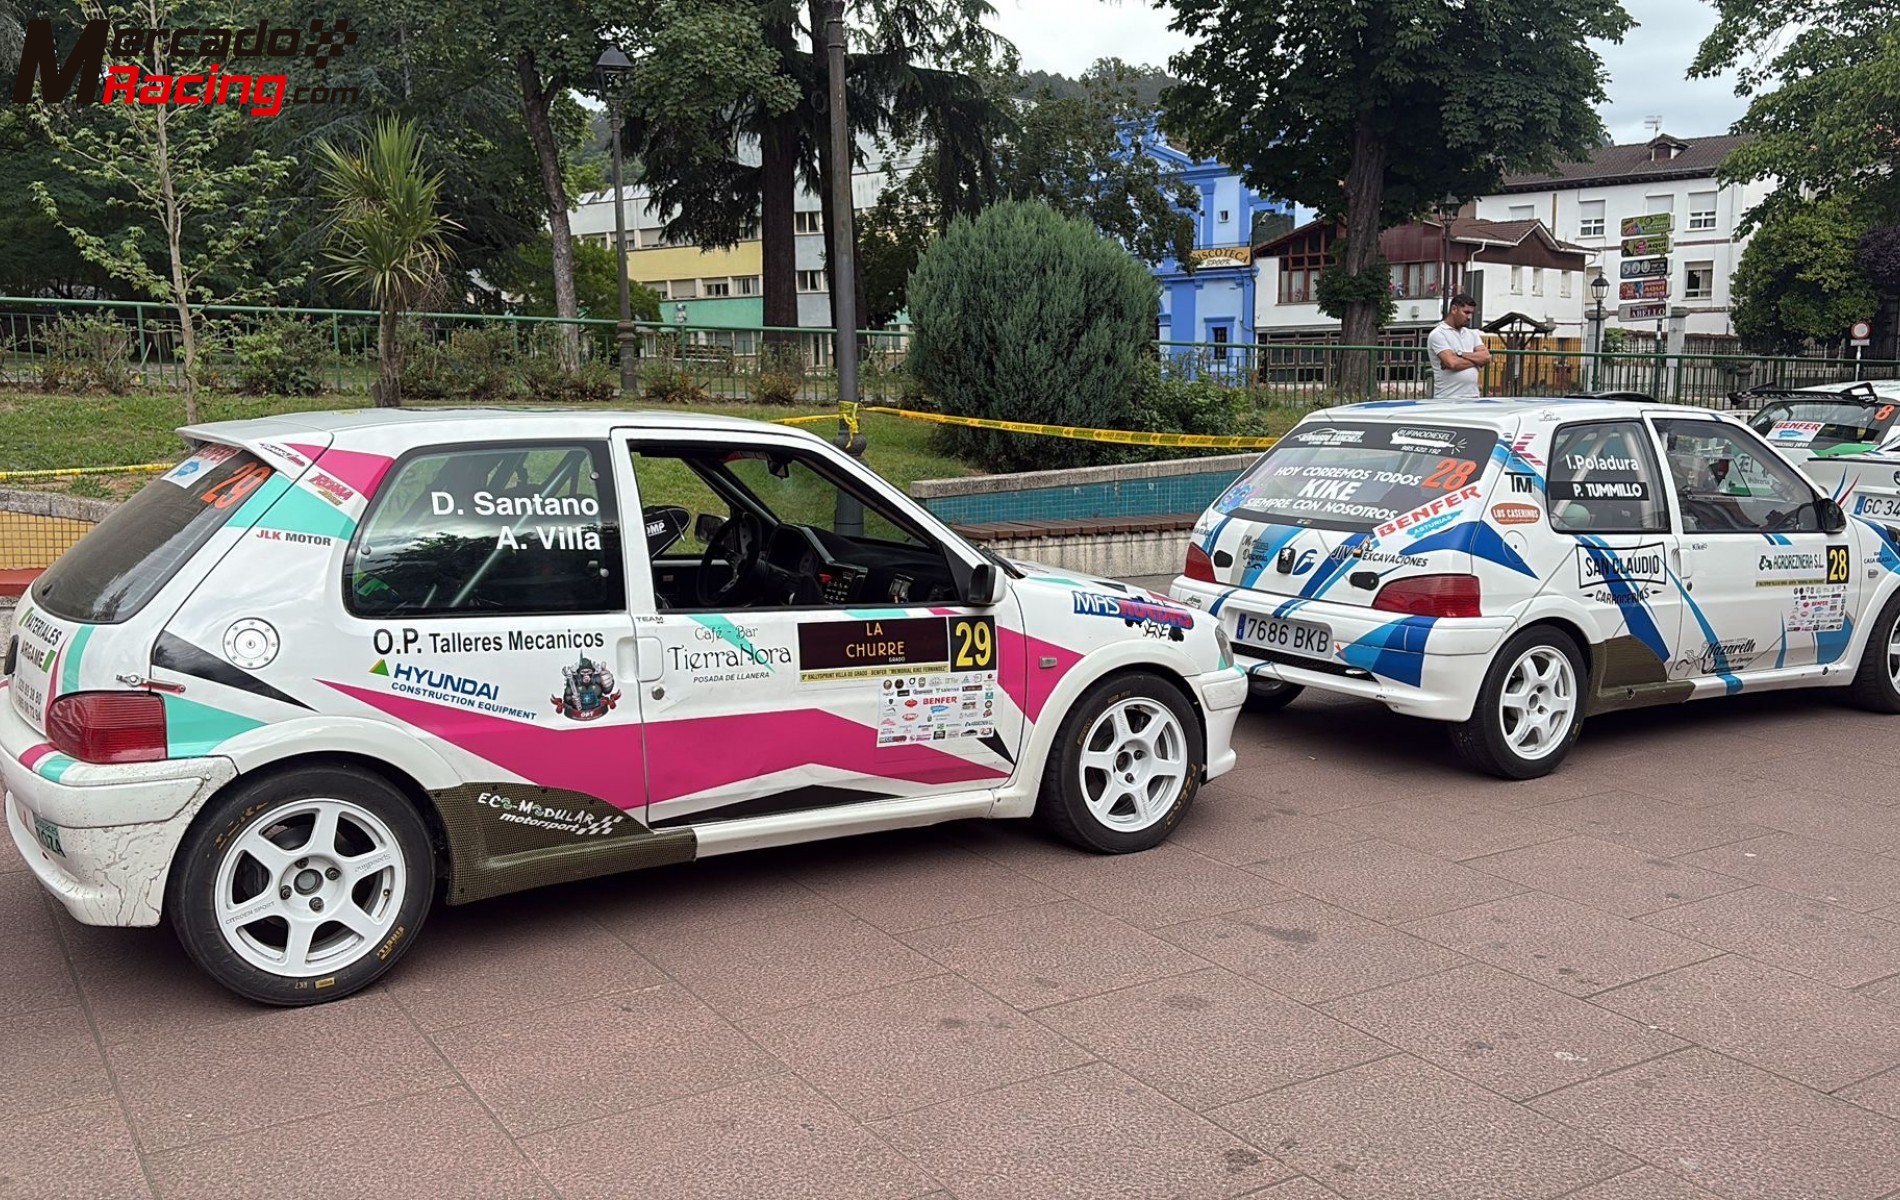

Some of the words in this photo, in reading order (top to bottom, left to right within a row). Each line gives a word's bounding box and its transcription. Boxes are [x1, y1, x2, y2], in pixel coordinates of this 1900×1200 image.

[1874, 404, 1896, 422] 8
[1775, 422, 1822, 431] BENFER
[1566, 454, 1640, 471] I.Poladura
[1274, 466, 1302, 477] HOY
[1302, 467, 1371, 480] CORREMOS
[1374, 471, 1422, 487] TODOS
[1421, 458, 1478, 491] 28
[200, 462, 273, 510] 29
[1298, 478, 1363, 501] KIKE
[1572, 483, 1584, 497] P.
[1585, 483, 1642, 497] TUMMILLO
[431, 491, 464, 516] D.
[474, 491, 599, 516] Santano
[1244, 497, 1292, 509] SIEMPRE
[1293, 500, 1320, 512] CON
[1322, 503, 1399, 521] NOSOTROS
[1378, 485, 1482, 538] BENFER
[1863, 499, 1882, 515] GC
[1413, 515, 1451, 534] ASTURIAS
[255, 529, 282, 542] JLK
[285, 531, 332, 547] MOTOR
[495, 525, 527, 551] A.
[536, 525, 601, 550] Villa
[1362, 551, 1429, 568] EXCAVACIONES
[1585, 557, 1609, 577] SAN
[1612, 555, 1660, 575] CLAUDIO
[1829, 548, 1847, 581] 28
[1075, 592, 1120, 614] MAS
[24, 613, 62, 646] MATERIALES
[694, 624, 723, 641] Café
[735, 624, 759, 639] Bar
[866, 622, 884, 637] LA
[1246, 618, 1289, 646] 7686
[1293, 626, 1330, 653] BKB
[373, 628, 422, 655] O.P.
[429, 632, 503, 654] Talleres
[508, 629, 604, 651] Mecanicos
[846, 641, 906, 658] CHURRE
[954, 621, 993, 668] 29
[667, 643, 792, 673] TierraNora
[393, 662, 500, 701] HYUNDAI
[693, 675, 724, 683] POSADA
[725, 673, 736, 681] DE
[736, 671, 770, 680] LLANERA
[391, 682, 476, 708] CONSTRUCTION
[477, 700, 537, 721] EQUIPMENT
[922, 696, 957, 705] BENFER
[477, 792, 595, 825] ECO-MODULAR
[499, 812, 580, 832] motorsport
